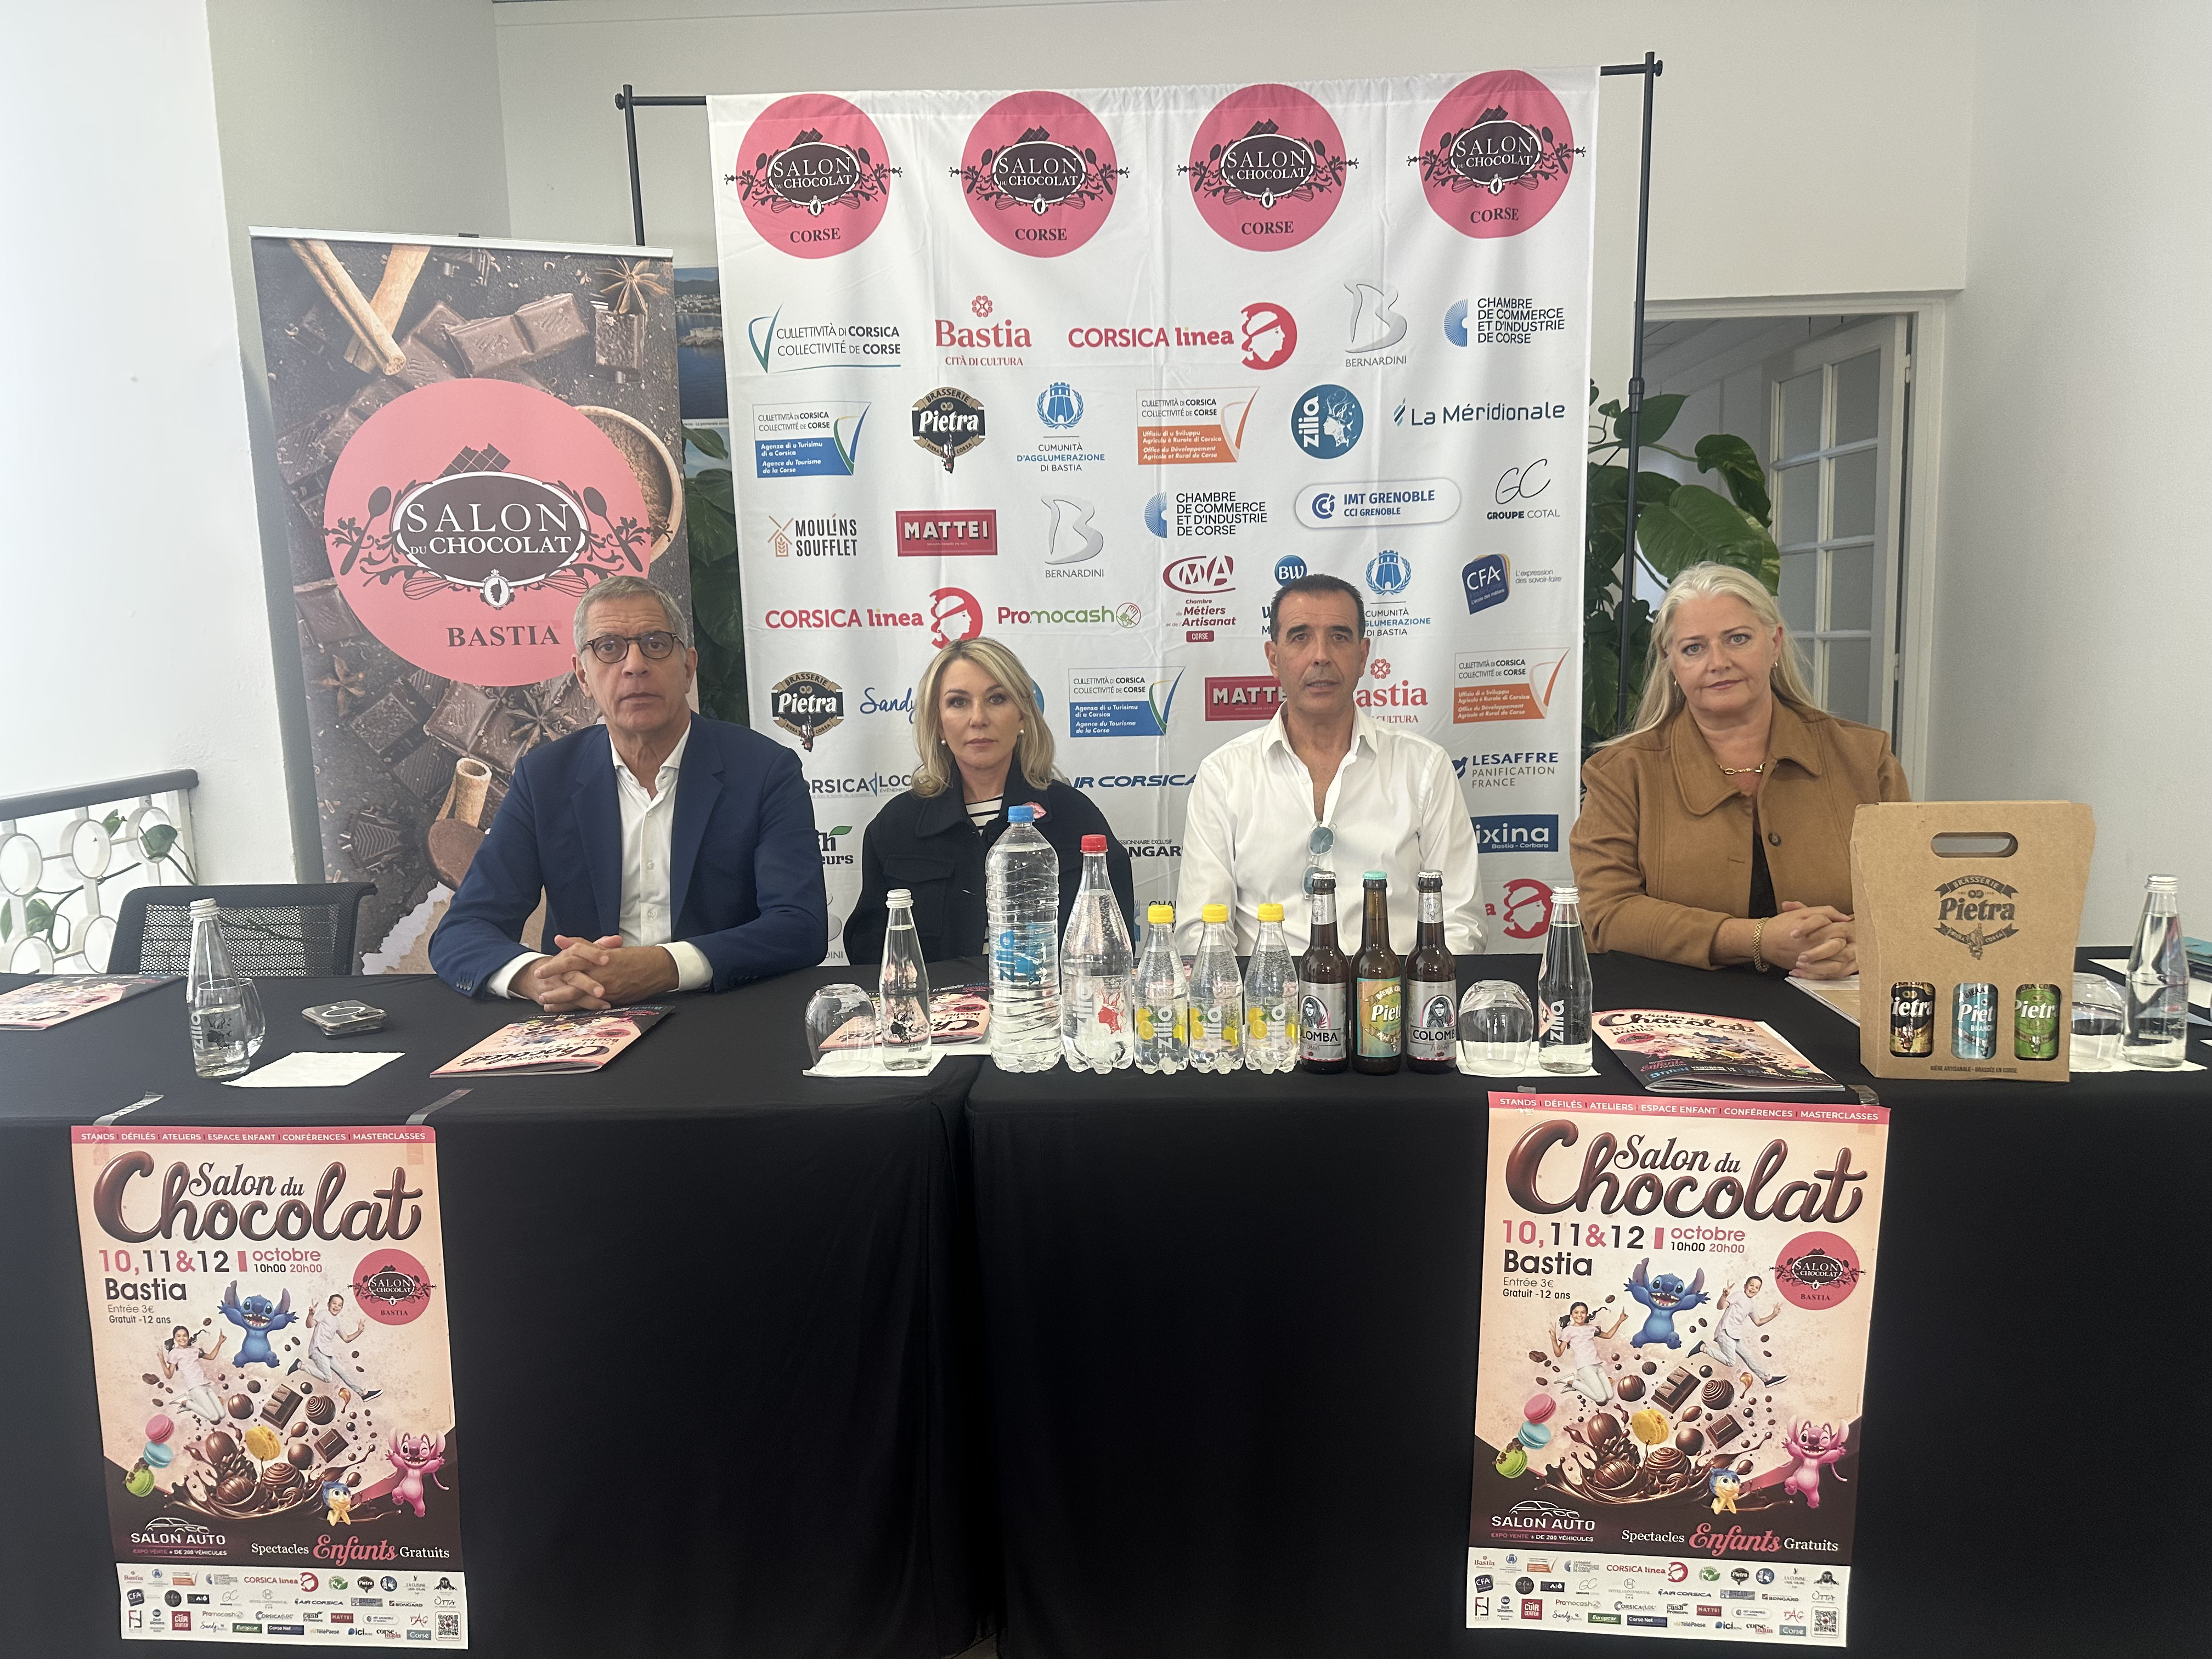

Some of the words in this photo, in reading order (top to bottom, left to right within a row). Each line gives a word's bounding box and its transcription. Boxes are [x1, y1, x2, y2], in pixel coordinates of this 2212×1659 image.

[1457, 136, 1533, 157] SALON
[999, 157, 1077, 174] SALON
[1227, 150, 1305, 168] SALON
[1466, 154, 1533, 167] CHOCOLAT
[774, 157, 850, 177] SALON
[1237, 167, 1306, 179] CHOCOLAT
[784, 174, 852, 188] CHOCOLAT
[1009, 176, 1078, 185] CHOCOLAT
[1470, 207, 1519, 223] CORSE
[790, 228, 840, 243] CORSE
[1015, 228, 1067, 241] CORSE
[1242, 221, 1294, 235] CORSE
[1477, 297, 1532, 309] CHAMBRE
[1478, 309, 1494, 320] DE
[1497, 308, 1564, 320] COMMERCE
[838, 328, 847, 336] DI
[848, 326, 900, 337] CORSICA
[935, 319, 1032, 347] Bastia
[1478, 320, 1493, 331] ET
[1496, 319, 1565, 332] D'INDUSTRIE
[1068, 328, 1170, 348] CORSICA
[1175, 328, 1234, 346] linea
[1478, 333, 1493, 343] DE
[1496, 332, 1531, 343] CORSE
[778, 340, 846, 356] COLLECTIVITÉ
[849, 345, 860, 354] DE
[862, 343, 900, 354] CORSE
[945, 355, 967, 365] CITÀ
[969, 358, 978, 366] DI
[980, 358, 1023, 366] CULTURA
[1346, 356, 1406, 367] BERNARDINI
[926, 388, 970, 404] BRASSERIE
[918, 410, 978, 433] Pietra
[1412, 408, 1435, 426] La
[1443, 402, 1565, 424] Méridionale
[1298, 396, 1319, 448] zilia
[1039, 442, 1083, 452] CUMUNITÀ
[1176, 492, 1236, 503] CHAMBRE
[1344, 493, 1366, 505] IMT
[1369, 490, 1435, 504] GRENOBLE
[1177, 504, 1192, 514] DE
[1195, 501, 1266, 514] COMMERCE
[1344, 508, 1357, 517] CCI
[1359, 507, 1401, 516] GRENOBLE
[1487, 511, 1524, 520] GROUPE
[1527, 509, 1560, 518] COTAL
[407, 503, 568, 532] SALON
[1177, 515, 1191, 525] ET
[1194, 513, 1267, 524] D'INDUSTRIE
[905, 521, 987, 538] MATTEI
[1177, 526, 1192, 536] DE
[1195, 525, 1235, 535] CORSE
[430, 536, 571, 554] CHOCOLAT
[796, 539, 857, 556] SOUFFLET
[1046, 569, 1104, 578] BERNARDINI
[1466, 566, 1501, 587] CFA
[998, 606, 1114, 624] Promocash
[1183, 606, 1226, 616] Métiers
[765, 609, 862, 629] CORSICA
[867, 609, 924, 627] linea
[446, 625, 561, 647] BASTIA
[778, 693, 837, 714] Pietra
[1472, 753, 1558, 766] LESAFFRE
[1472, 766, 1554, 777] PANIFICATION
[1472, 778, 1515, 788] FRANCE
[1953, 876, 2000, 889] BRASSERIE
[1938, 898, 2015, 921] Pietra
[1154, 1005, 1172, 1049] zilia
[1550, 1000, 1565, 1042] zilia
[1598, 1014, 1754, 1032] Chocolat
[1413, 1029, 1455, 1041] COLOMB
[1544, 1099, 1582, 1108] DÉFILÉS
[1590, 1102, 1633, 1110] ATELIERS
[1641, 1104, 1677, 1113] ESPACE
[1724, 1108, 1792, 1117] CONFÉRENCES
[1801, 1111, 1878, 1120] MASTERCLASSES
[1613, 1135, 1711, 1171] Salon
[1714, 1152, 1741, 1173] du
[1505, 1119, 1868, 1223] Chocolat
[189, 1163, 276, 1197] Salon
[280, 1176, 304, 1196] du
[93, 1150, 423, 1243] Chocolat
[1671, 1226, 1745, 1242] octobre
[252, 1248, 321, 1261] octobre
[1671, 1242, 1705, 1251] 10h00
[1709, 1243, 1745, 1253] 20h00
[254, 1264, 286, 1273] 10h00
[290, 1264, 322, 1273] 20h00
[1504, 1249, 1592, 1276] Bastia
[105, 1278, 187, 1300] Bastia
[1504, 1277, 1537, 1287] Entrée
[1541, 1279, 1554, 1288] 3€
[1503, 1288, 1532, 1297] Gratuit
[1536, 1290, 1551, 1299] -12
[108, 1304, 139, 1313] Entrée
[142, 1305, 154, 1313] 3€
[109, 1315, 136, 1323] Gratuit
[139, 1316, 153, 1324] -12
[1492, 1516, 1546, 1528] SALON
[1551, 1519, 1595, 1531] AUTO
[131, 1533, 181, 1543] SALON
[186, 1534, 225, 1545] AUTO
[1622, 1530, 1684, 1543] Spectacles
[1689, 1523, 1782, 1556] Enfants
[1784, 1538, 1838, 1551] Gratuits
[251, 1543, 309, 1555] Spectacles
[313, 1534, 398, 1566] Enfants
[400, 1547, 449, 1558] Gratuits
